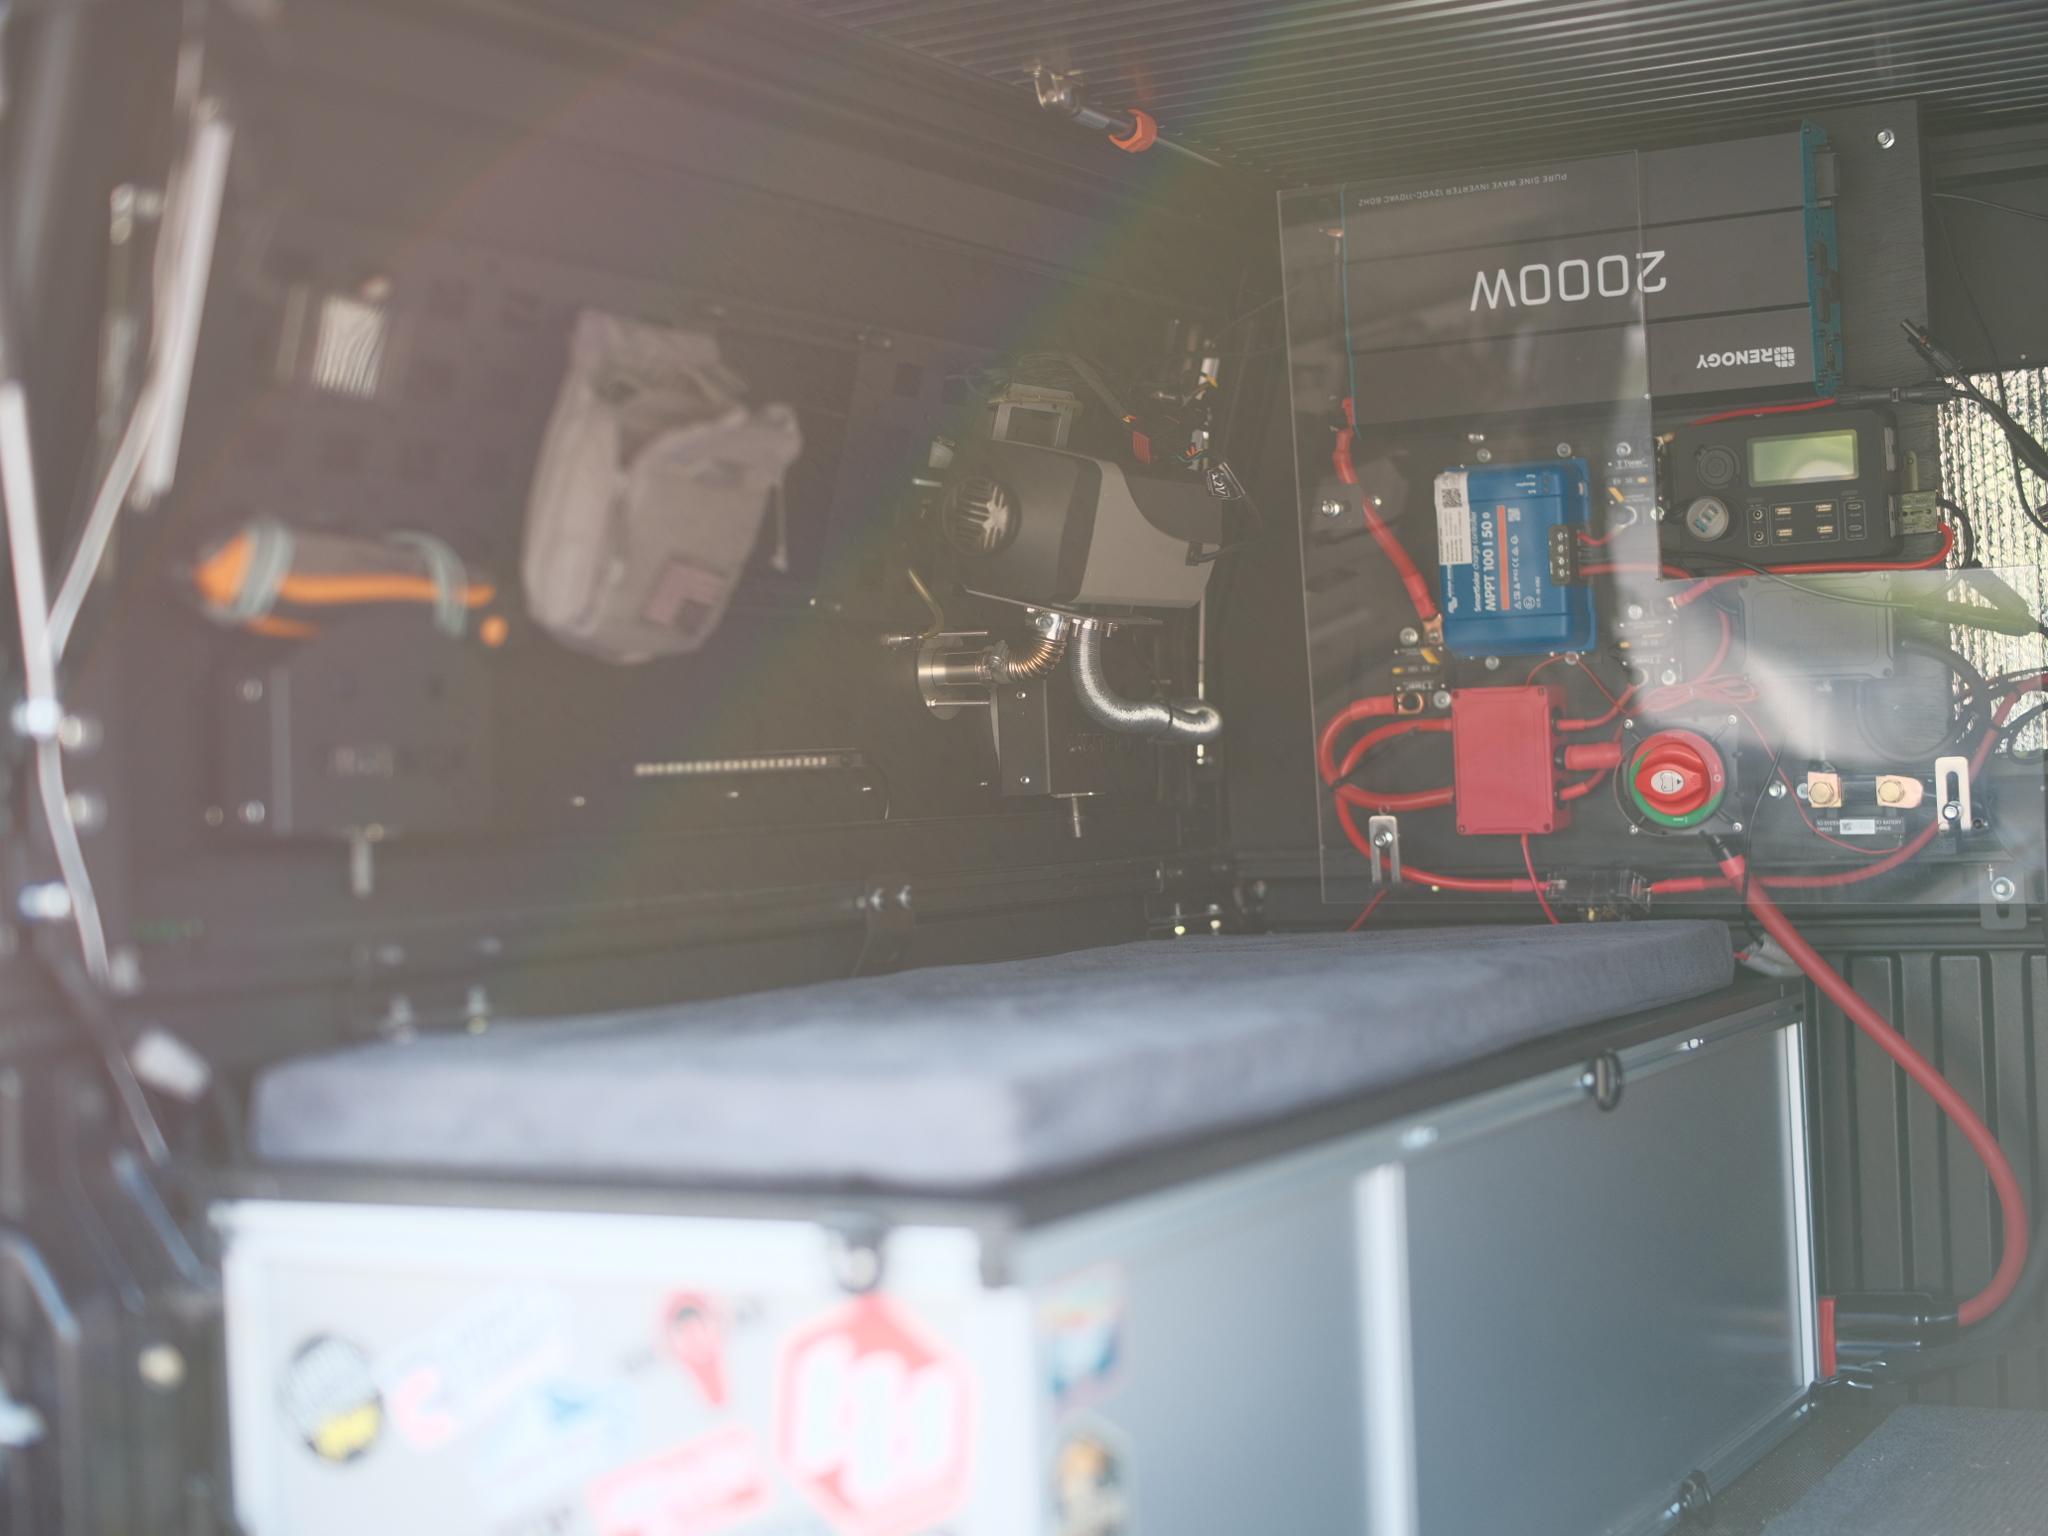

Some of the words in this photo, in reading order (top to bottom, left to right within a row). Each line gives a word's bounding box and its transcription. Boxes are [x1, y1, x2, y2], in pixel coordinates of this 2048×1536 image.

[1491, 179, 1517, 190] WAVE
[1520, 176, 1540, 187] SINE
[1542, 173, 1568, 182] PURE
[1446, 183, 1489, 197] INVERTER
[1470, 250, 1667, 311] 2000W
[1696, 347, 1773, 369] RENOGY
[1480, 521, 1493, 538] 50
[1482, 549, 1495, 572] 100
[1483, 574, 1497, 611] MPPT
